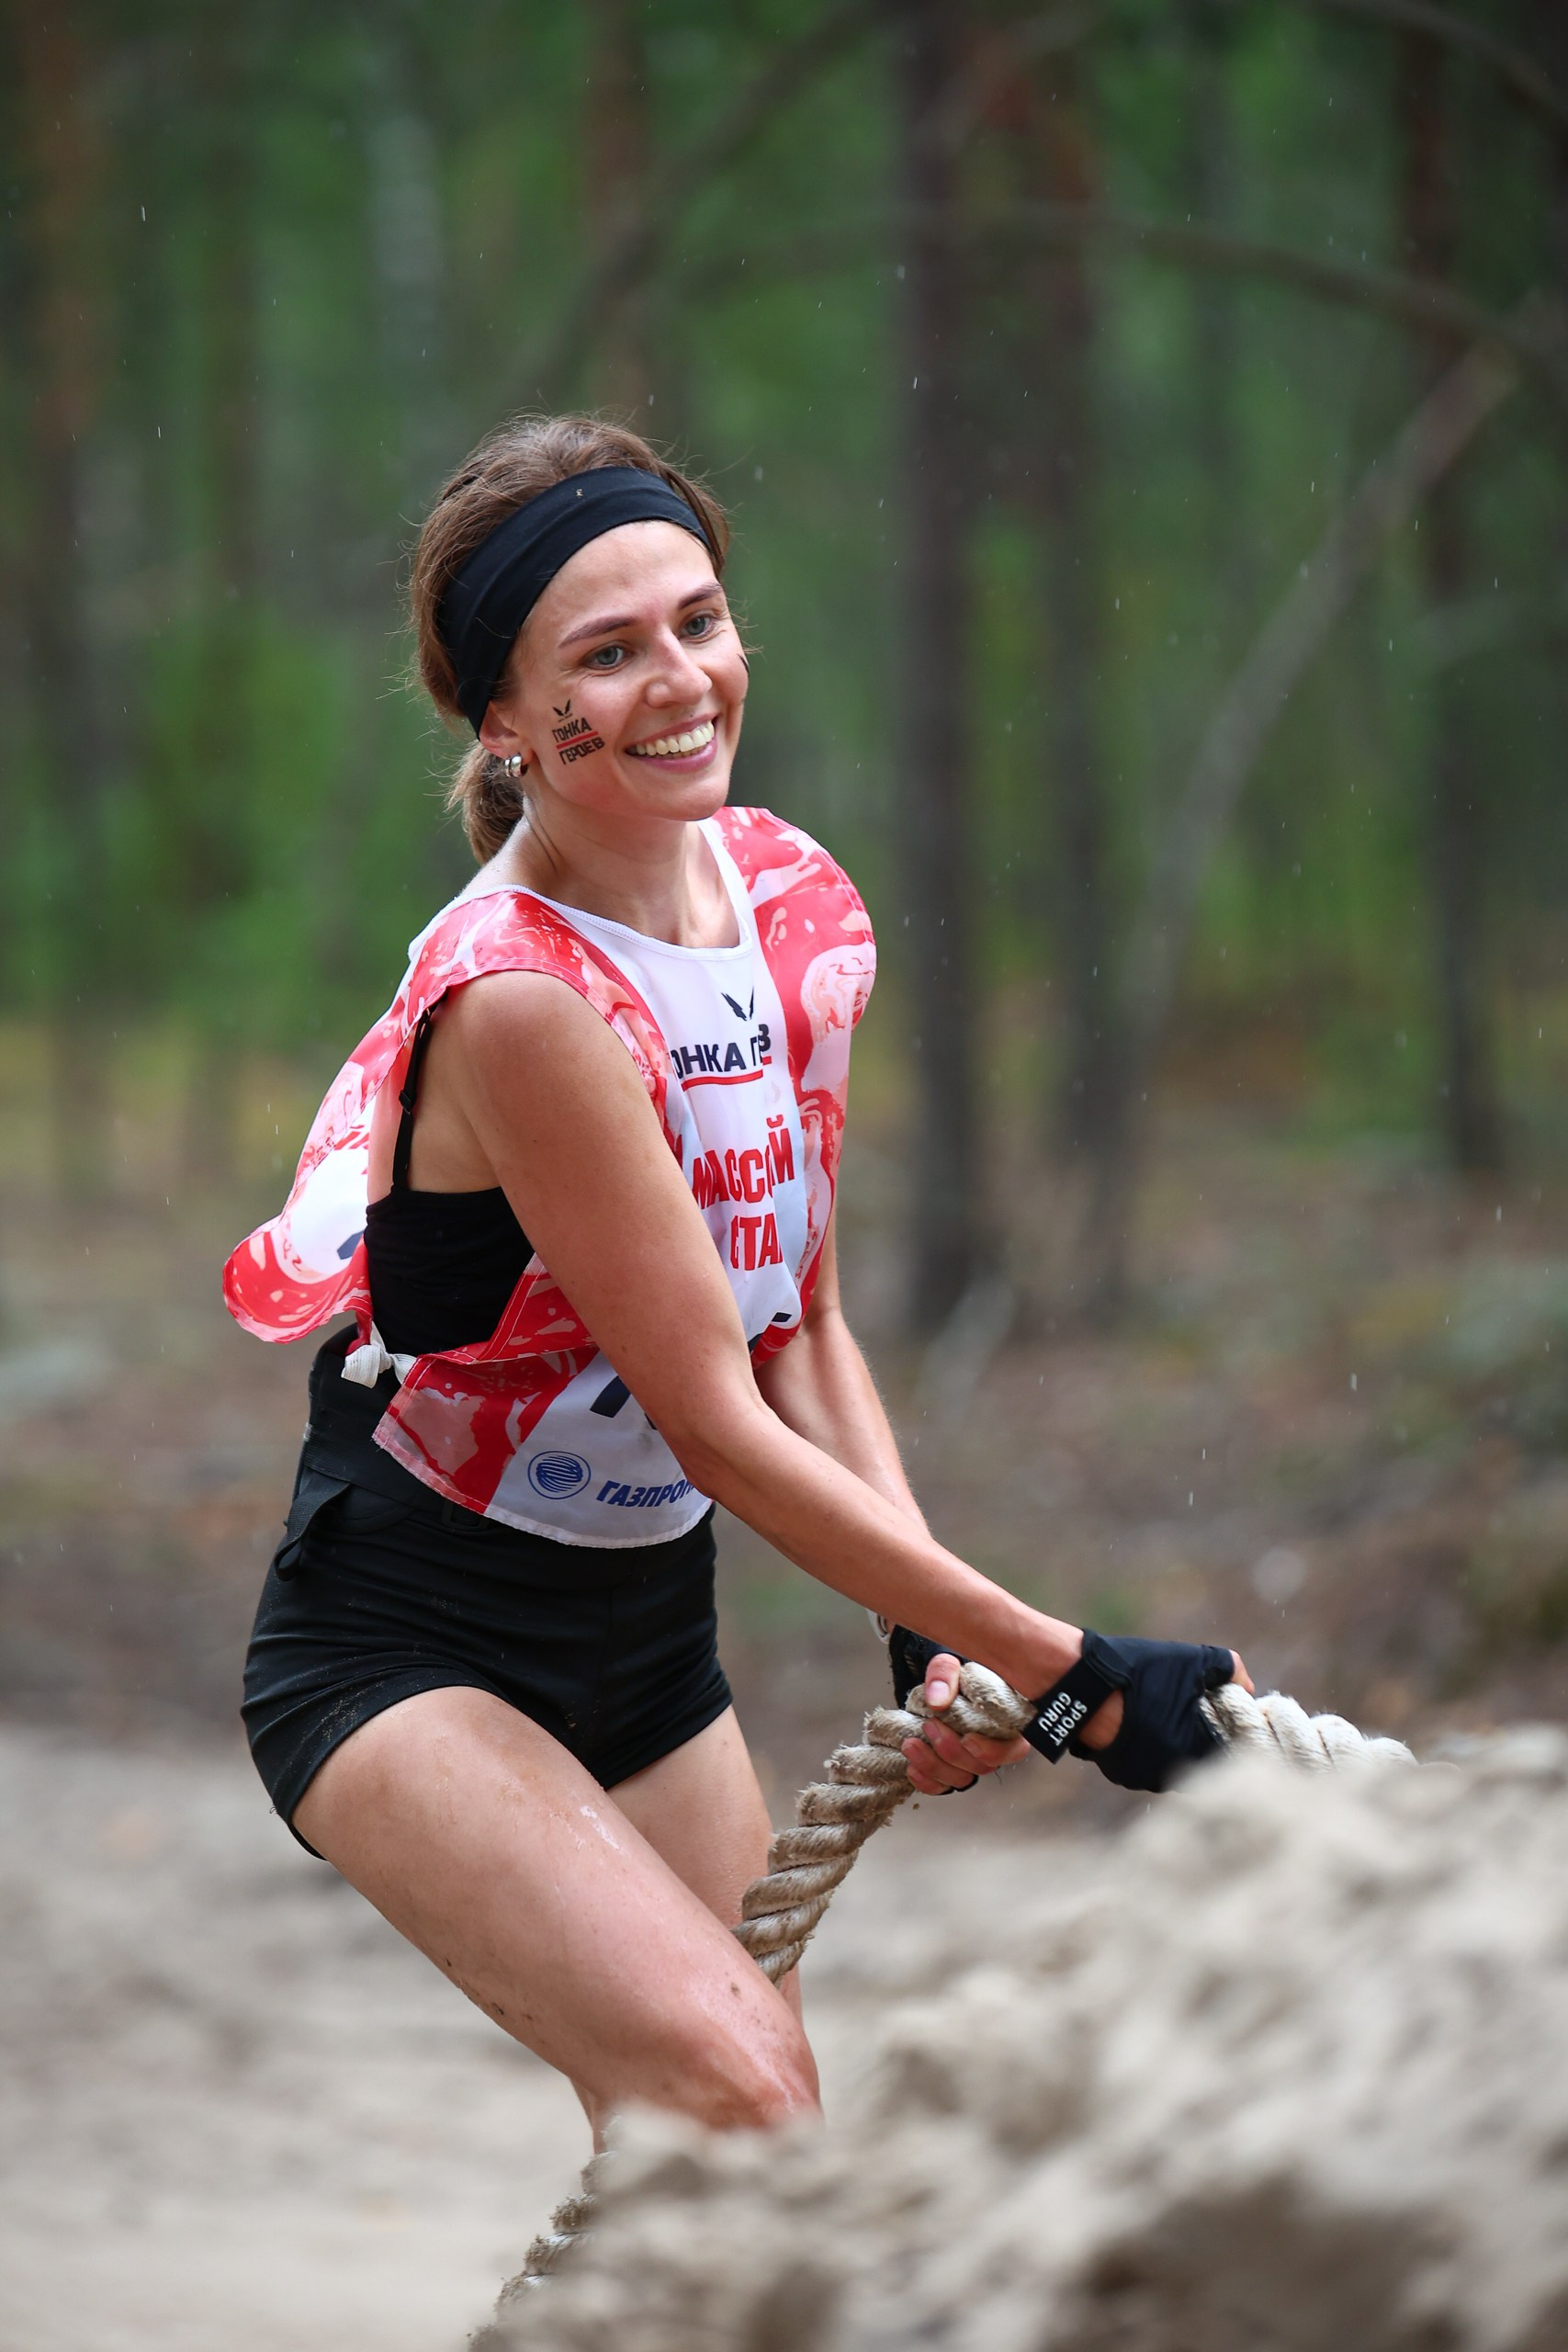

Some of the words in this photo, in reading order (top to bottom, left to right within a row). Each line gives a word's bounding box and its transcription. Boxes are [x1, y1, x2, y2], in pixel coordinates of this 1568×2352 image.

[551, 717, 592, 742] ГОНКА
[558, 737, 605, 765] ГЕРОЕВ
[671, 1042, 747, 1079] ОНКА
[1038, 1691, 1072, 1732] GURU
[1049, 1700, 1088, 1746] SPORT
